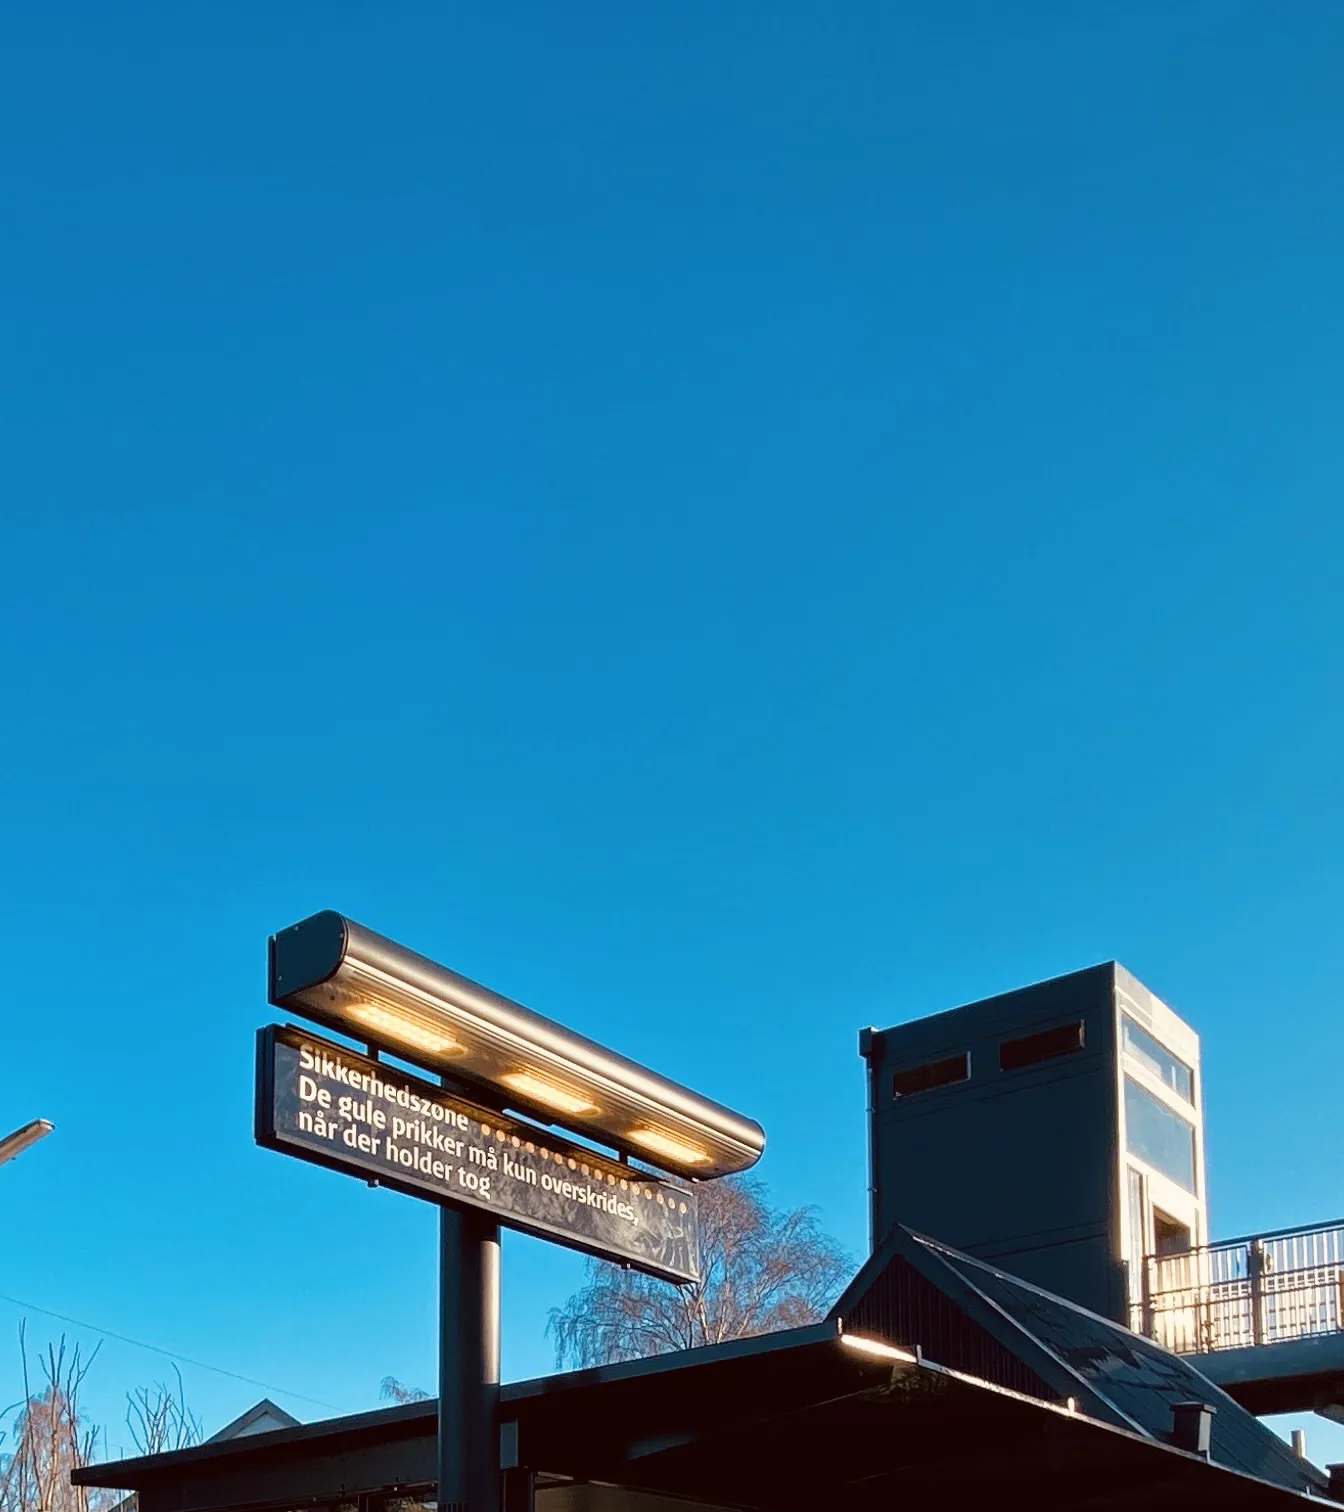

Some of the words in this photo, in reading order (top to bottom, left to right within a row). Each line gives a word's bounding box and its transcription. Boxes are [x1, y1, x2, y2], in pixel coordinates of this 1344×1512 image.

[299, 1044, 469, 1131] Sikkerhedszone
[298, 1110, 338, 1140] når
[343, 1124, 381, 1155] der
[386, 1137, 453, 1181] holder
[457, 1166, 492, 1199] tog
[299, 1075, 332, 1109] De
[338, 1096, 386, 1130] gule
[392, 1116, 465, 1158] prikker
[468, 1146, 498, 1170] må
[503, 1153, 537, 1186] kun
[541, 1174, 639, 1226] overskrides,
